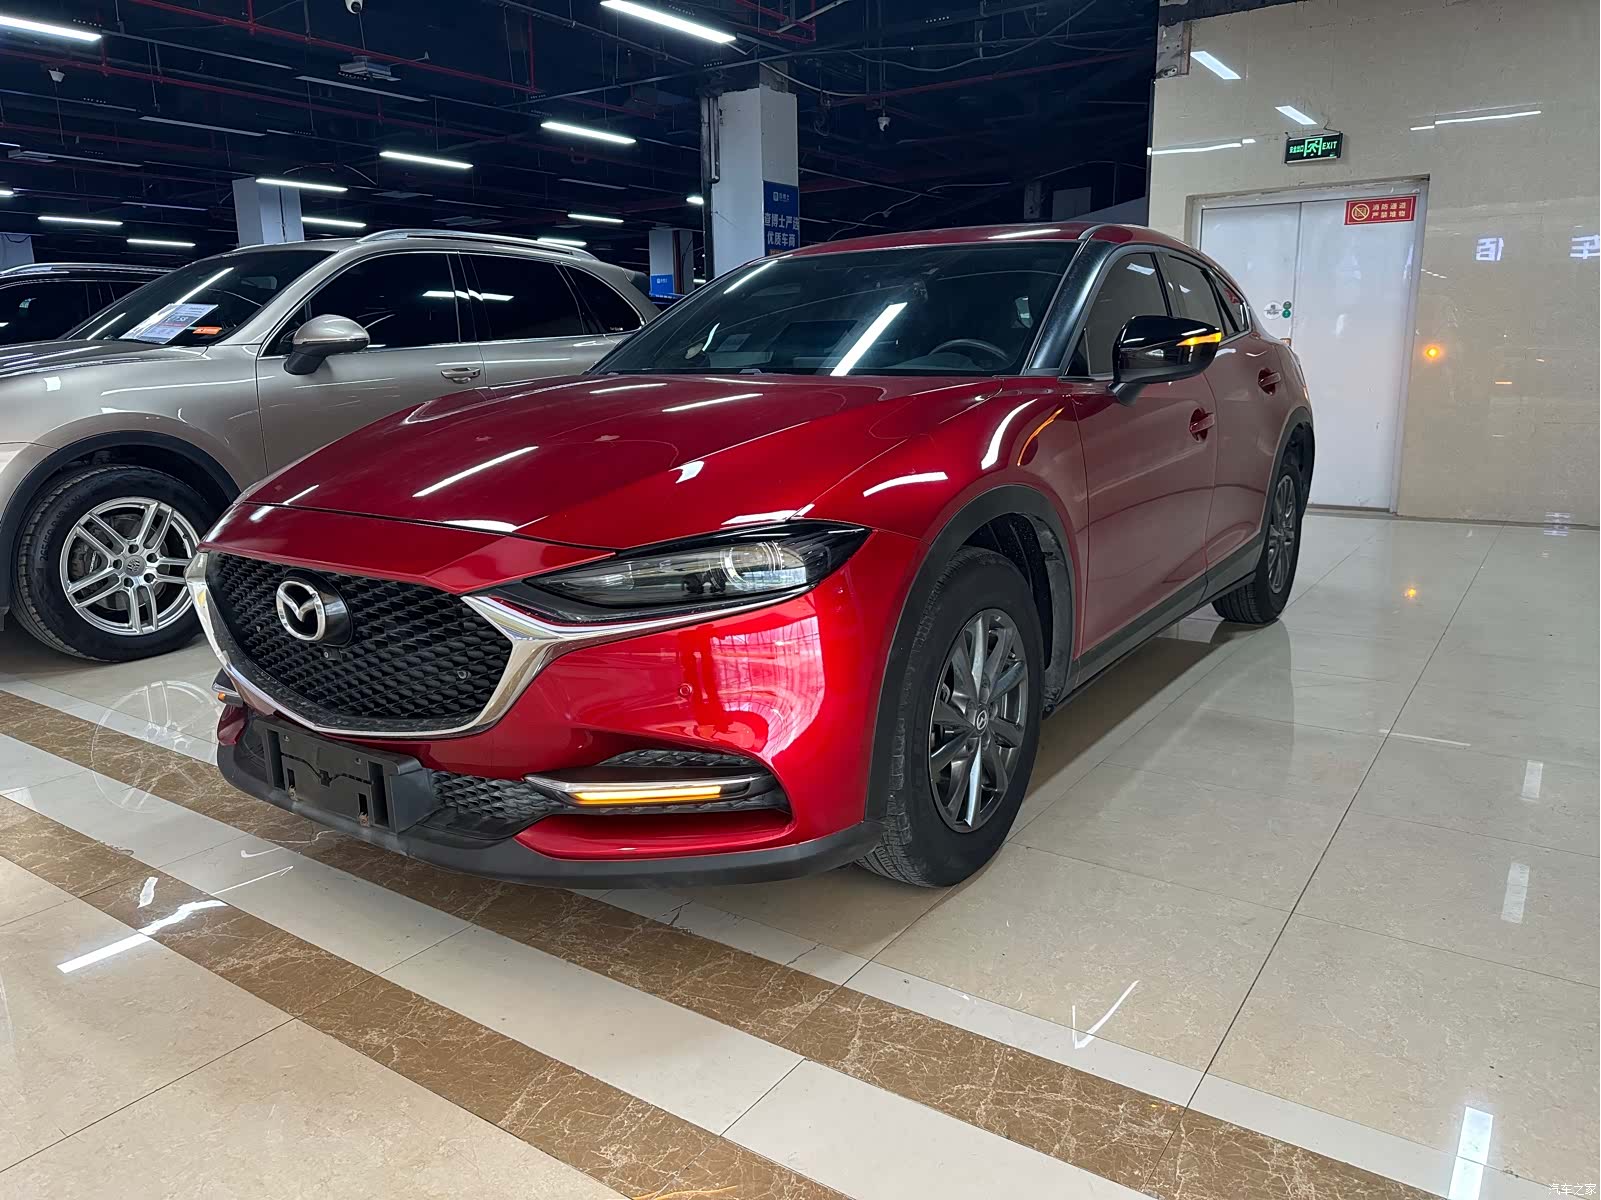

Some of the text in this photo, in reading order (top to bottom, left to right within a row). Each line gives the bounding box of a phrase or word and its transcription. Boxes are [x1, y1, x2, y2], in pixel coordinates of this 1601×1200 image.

[1322, 141, 1337, 150] EXIT
[1372, 202, 1406, 210] 消防通道
[764, 212, 800, 230] 查博士严选
[767, 230, 795, 247] 优质车商
